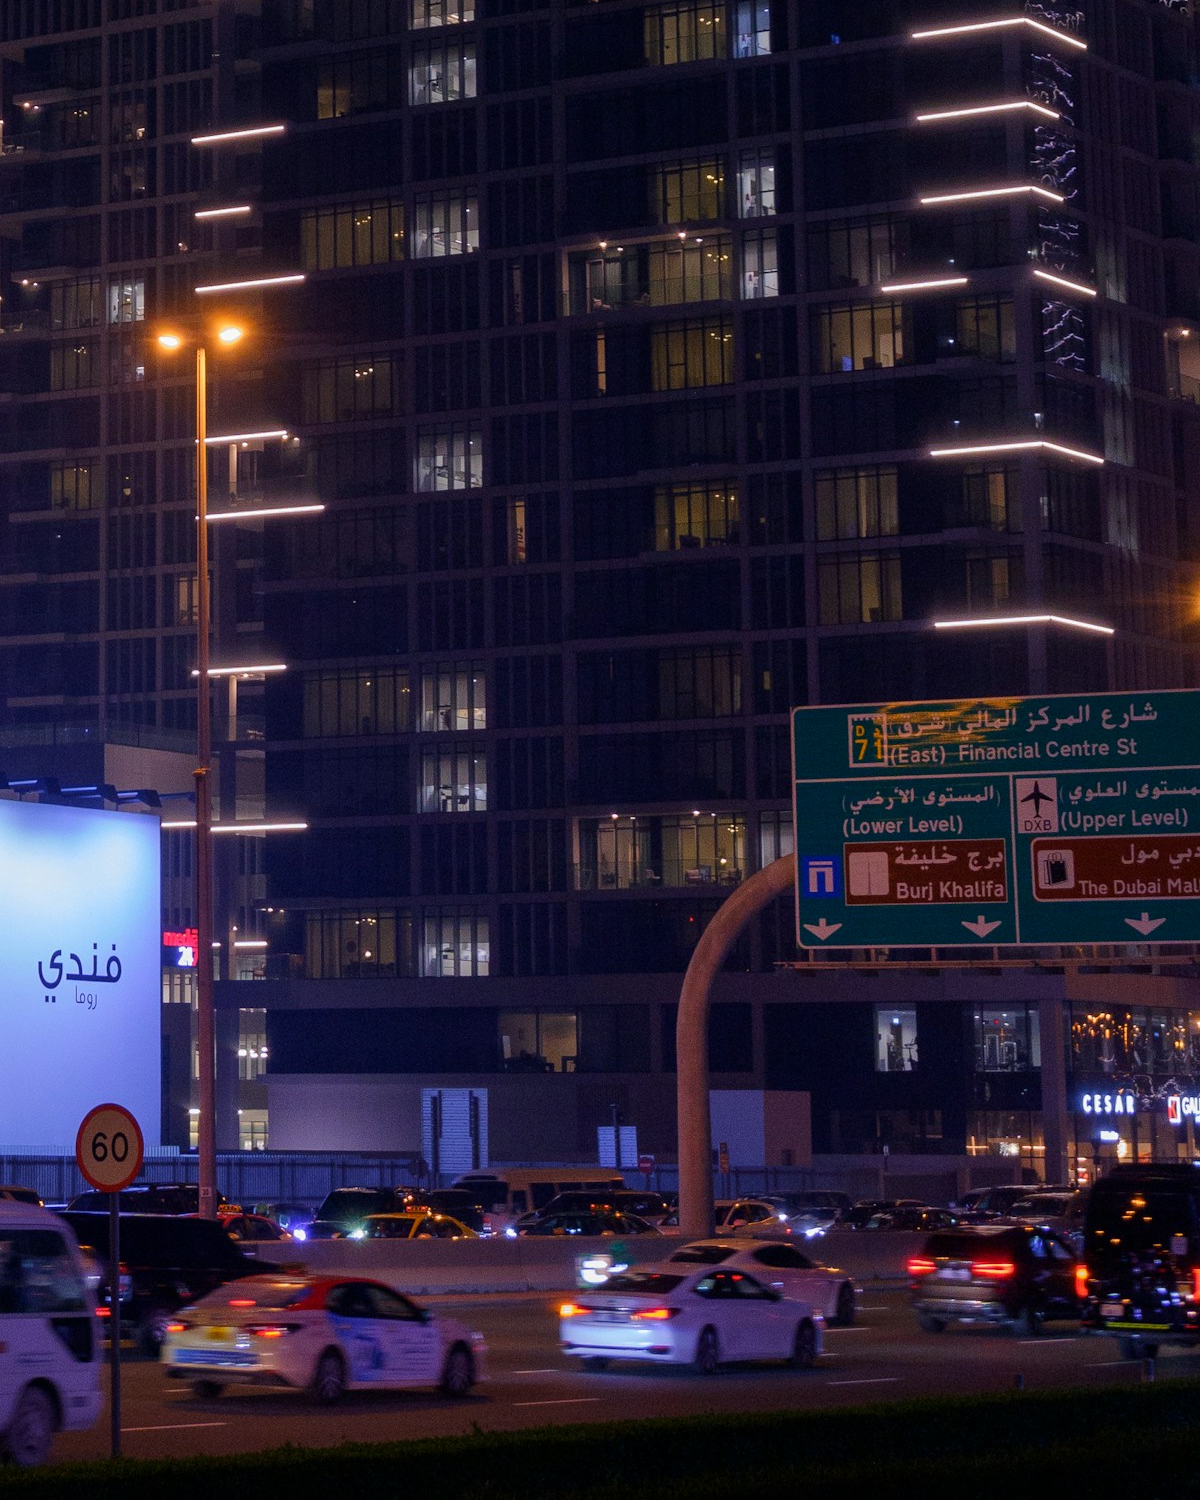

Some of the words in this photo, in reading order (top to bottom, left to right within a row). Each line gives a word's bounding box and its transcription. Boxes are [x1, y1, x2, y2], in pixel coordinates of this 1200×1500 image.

[957, 708, 1017, 741] المالي
[1026, 704, 1090, 732] المركز
[1101, 702, 1158, 730] شارع
[855, 725, 865, 737] D
[855, 739, 883, 760] 71
[891, 745, 945, 766] (East)
[959, 742, 1041, 761] Financial
[1046, 740, 1109, 758] Centre
[1117, 738, 1138, 755] St
[843, 818, 903, 837] (Lower
[909, 815, 963, 835] Level)
[1024, 820, 1052, 832] DXB
[1061, 811, 1125, 832] (Upper
[1132, 808, 1188, 827] Level)
[894, 846, 958, 870] خليفة
[967, 851, 1004, 871] برج
[1121, 844, 1159, 864] مول
[896, 882, 933, 900] Burj
[940, 880, 1004, 899] Khalifa
[1078, 880, 1108, 895] The
[1114, 879, 1161, 895] Dubai
[1167, 878, 1200, 893] Mal
[38, 943, 122, 1003] فندي
[75, 985, 98, 1010] روما
[91, 1132, 129, 1162] 60
